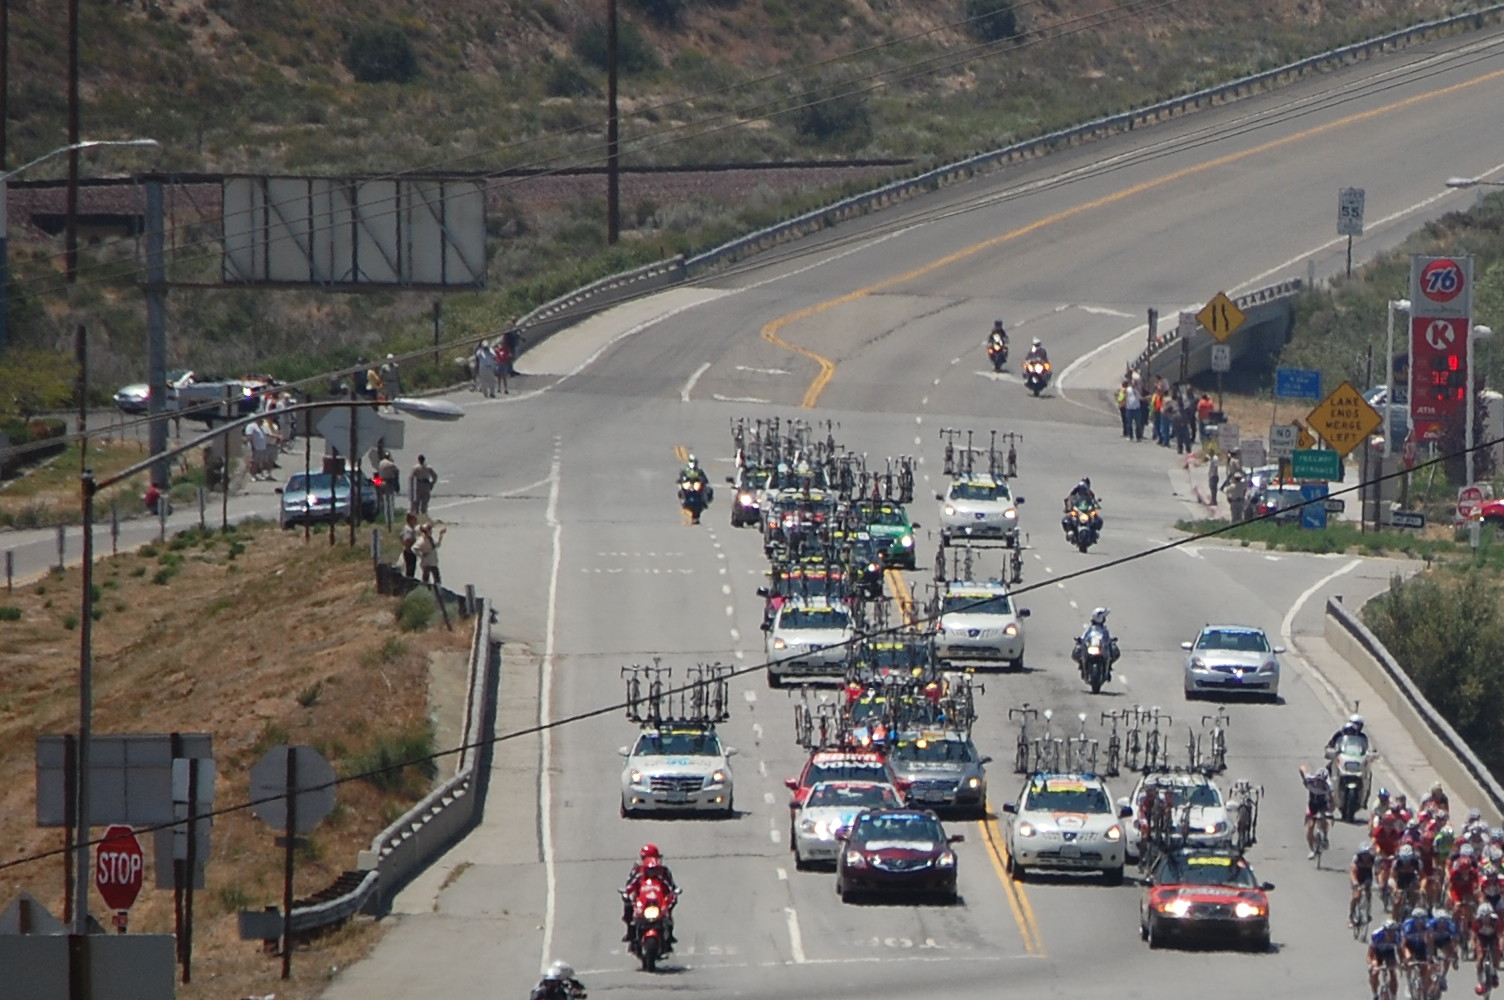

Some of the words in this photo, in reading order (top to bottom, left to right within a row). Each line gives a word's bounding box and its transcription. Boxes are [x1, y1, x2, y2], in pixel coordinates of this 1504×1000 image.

[1341, 206, 1359, 218] 55
[1427, 267, 1457, 293] 76
[1431, 322, 1454, 349] K
[1330, 397, 1359, 407] LANE
[1330, 408, 1359, 418] ENDS
[1417, 406, 1436, 414] ATM
[1325, 421, 1362, 431] MERGE
[1276, 428, 1292, 438] NO
[1329, 433, 1357, 443] LEFT
[1295, 464, 1335, 474] ENTRANCE
[98, 851, 141, 885] STOP
